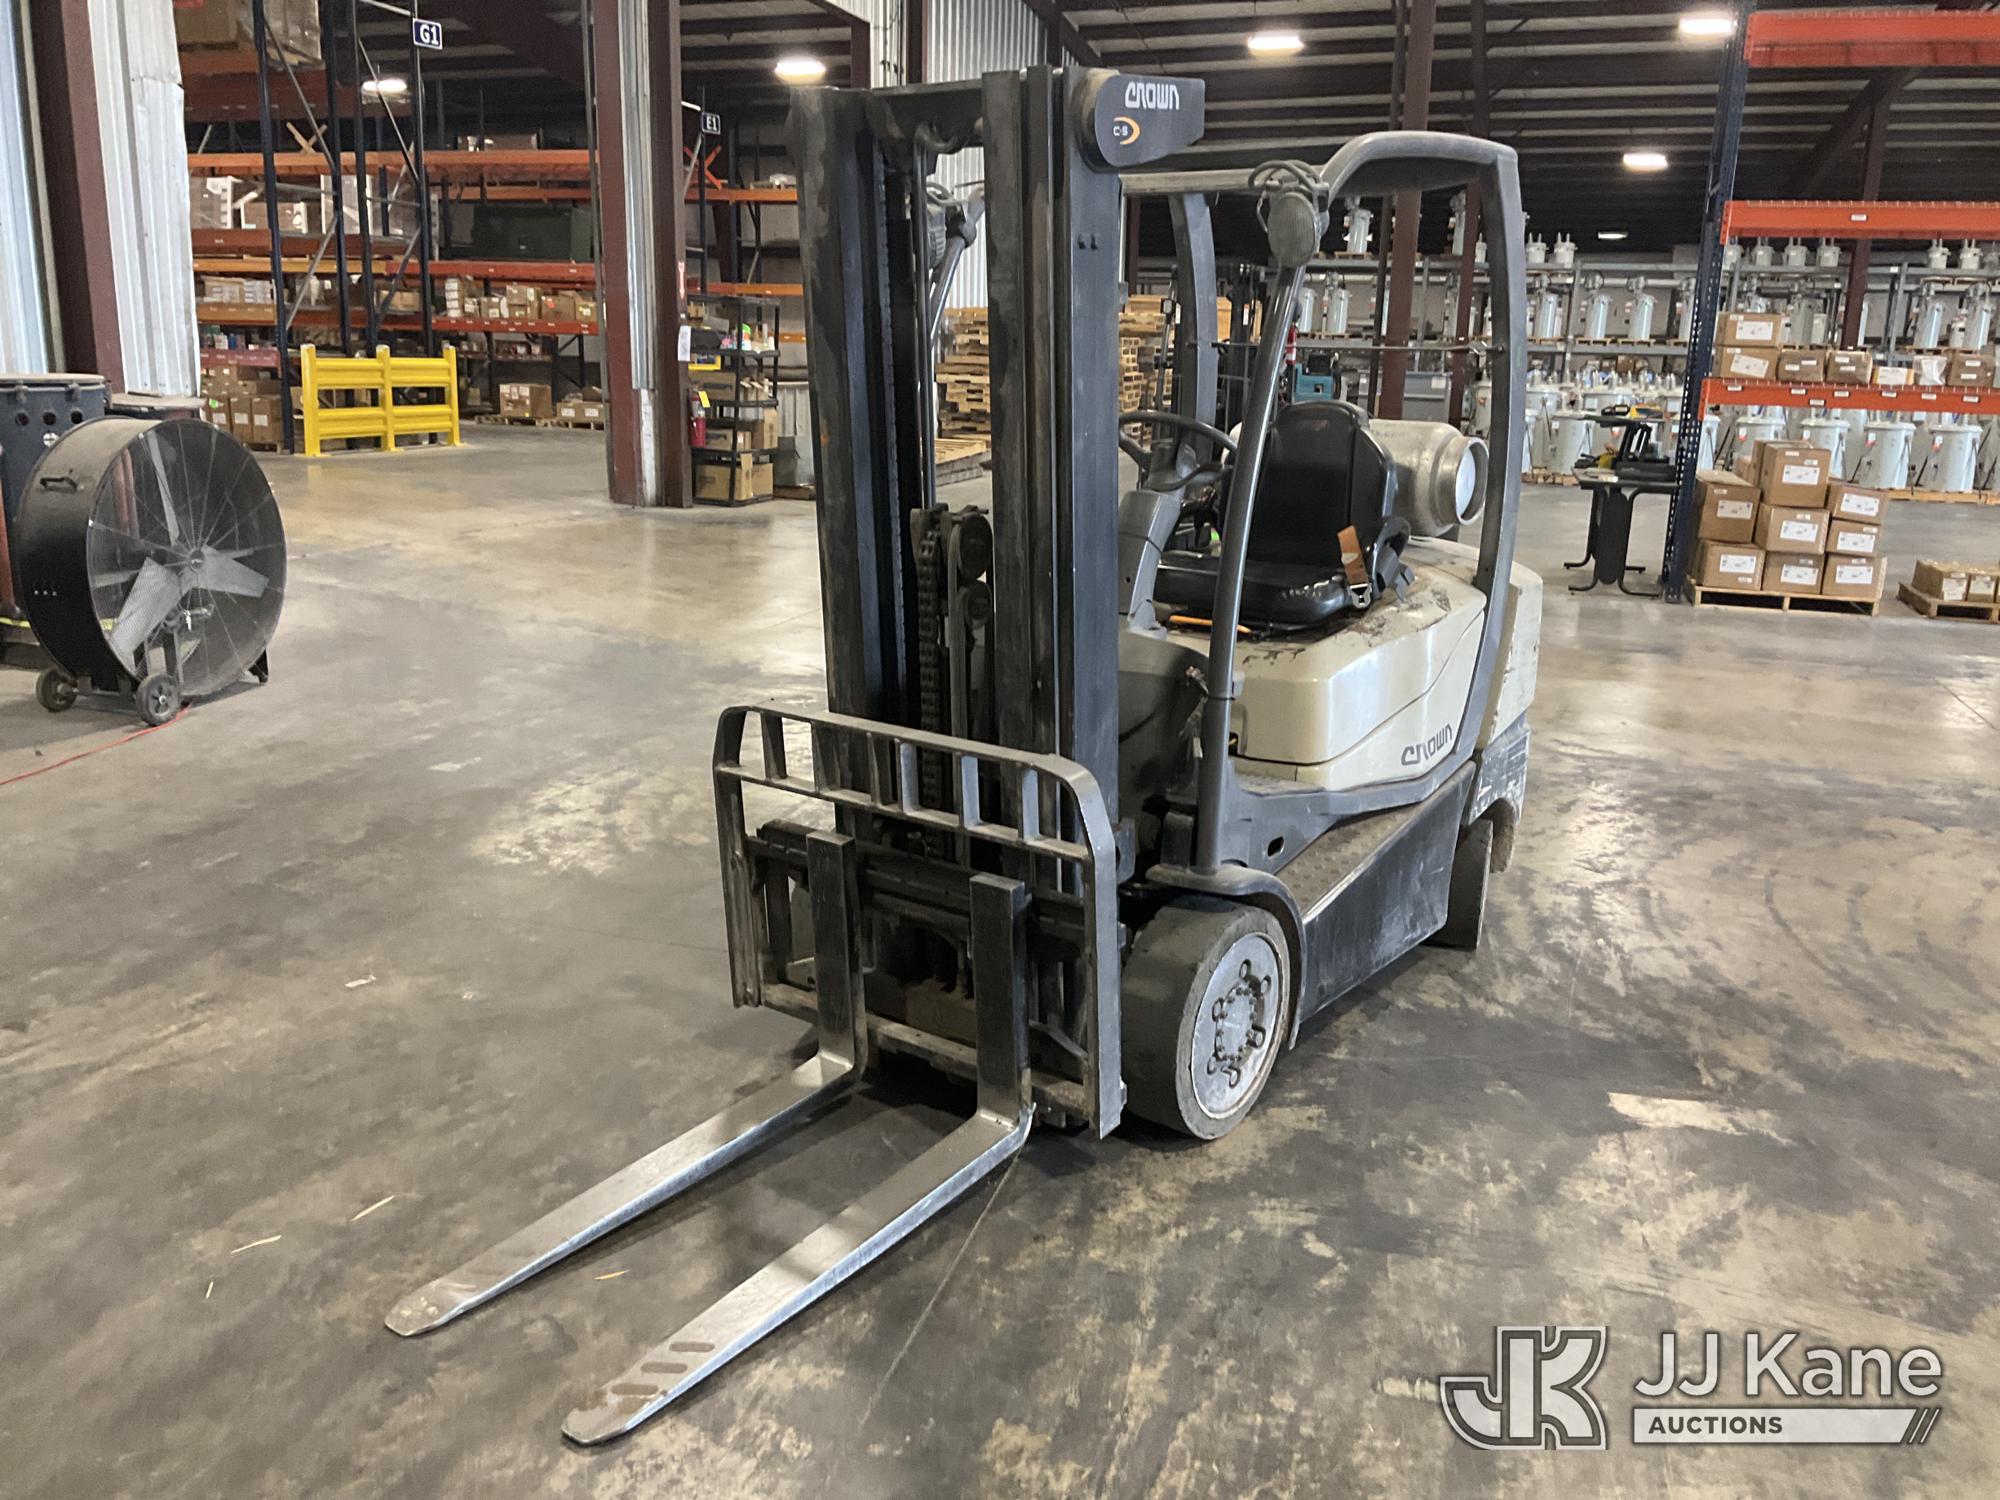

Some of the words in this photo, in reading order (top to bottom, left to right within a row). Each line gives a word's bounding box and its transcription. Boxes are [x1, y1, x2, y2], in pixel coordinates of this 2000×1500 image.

[420, 23, 439, 45] G1
[1125, 81, 1180, 110] CROWN
[706, 116, 717, 131] E1
[1401, 723, 1453, 765] CROWN
